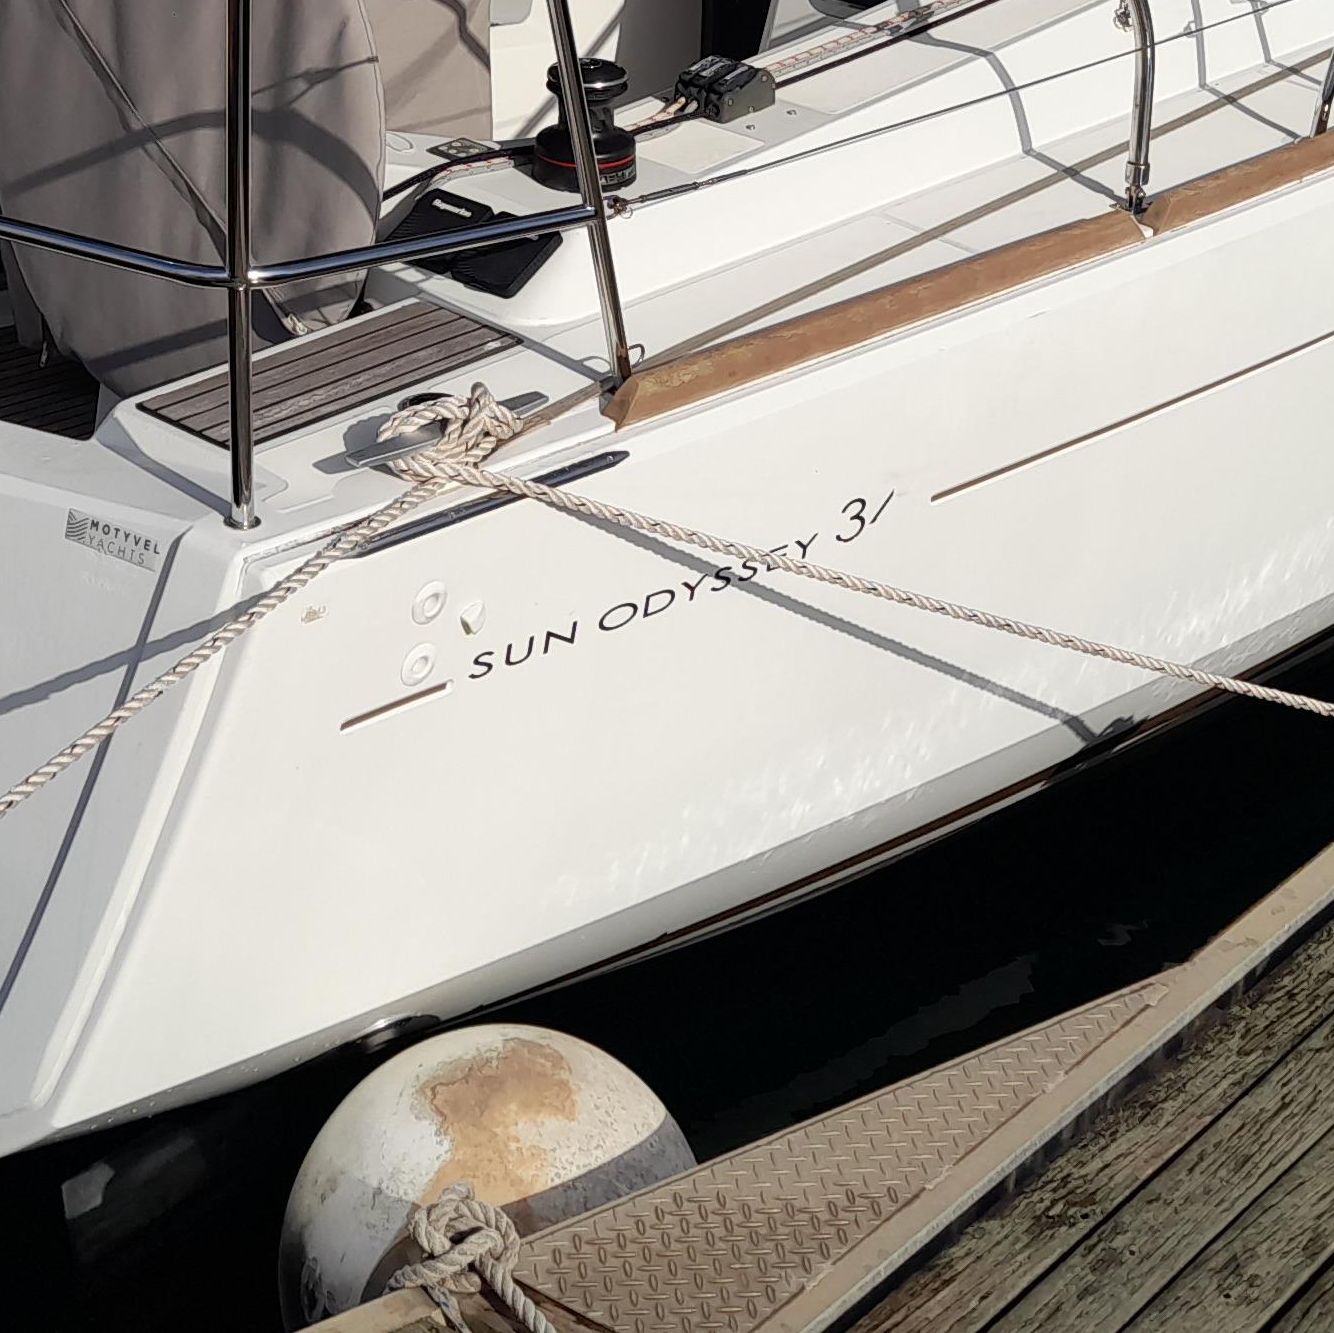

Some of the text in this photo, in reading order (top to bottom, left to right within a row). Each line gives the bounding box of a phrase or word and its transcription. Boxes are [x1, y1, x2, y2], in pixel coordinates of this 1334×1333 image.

[88, 534, 145, 565] YACHTS
[89, 519, 161, 555] MOTYVEL
[468, 620, 579, 680] SUN
